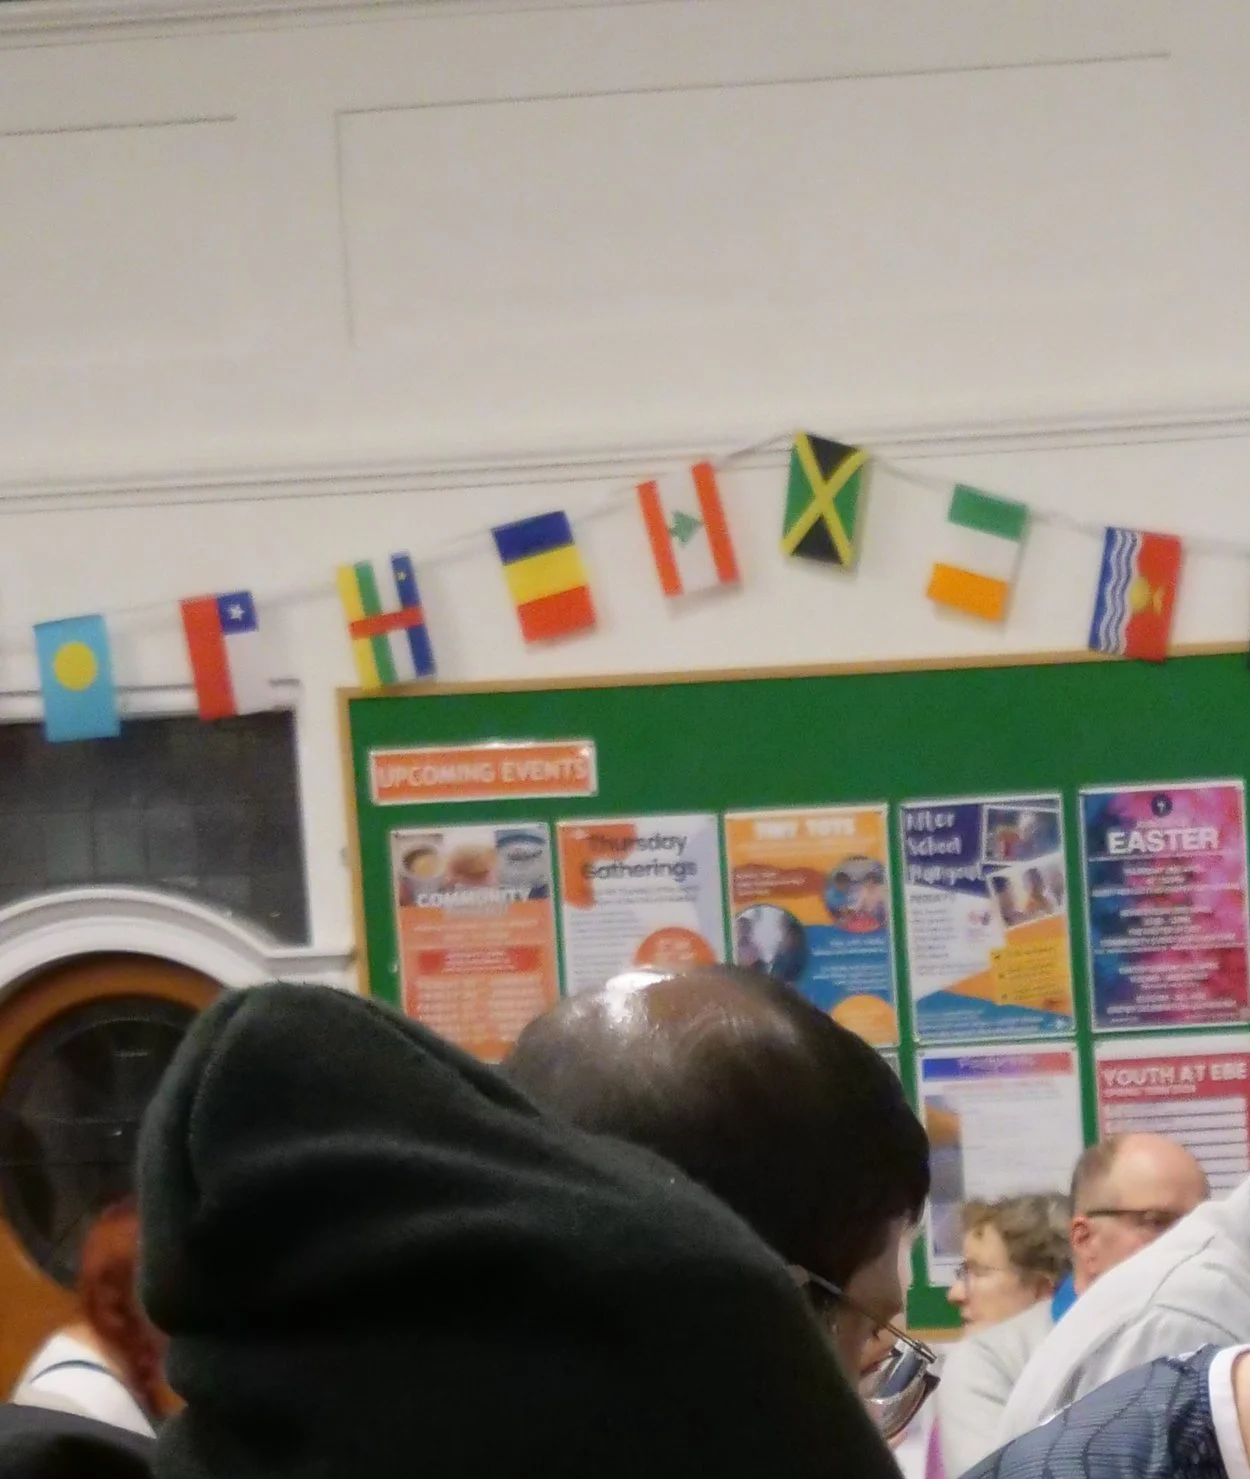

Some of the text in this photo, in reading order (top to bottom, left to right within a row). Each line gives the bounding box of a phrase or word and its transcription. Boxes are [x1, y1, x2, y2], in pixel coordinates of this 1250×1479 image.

[377, 759, 588, 788] UPCOMING EVENTS
[587, 833, 687, 856] Thursday
[1107, 827, 1219, 854] EASTER
[581, 859, 698, 882] Gatherings
[416, 887, 532, 906] COMMUNITY
[1102, 1066, 1175, 1086] YOUTH
[1180, 1064, 1206, 1082] AT
